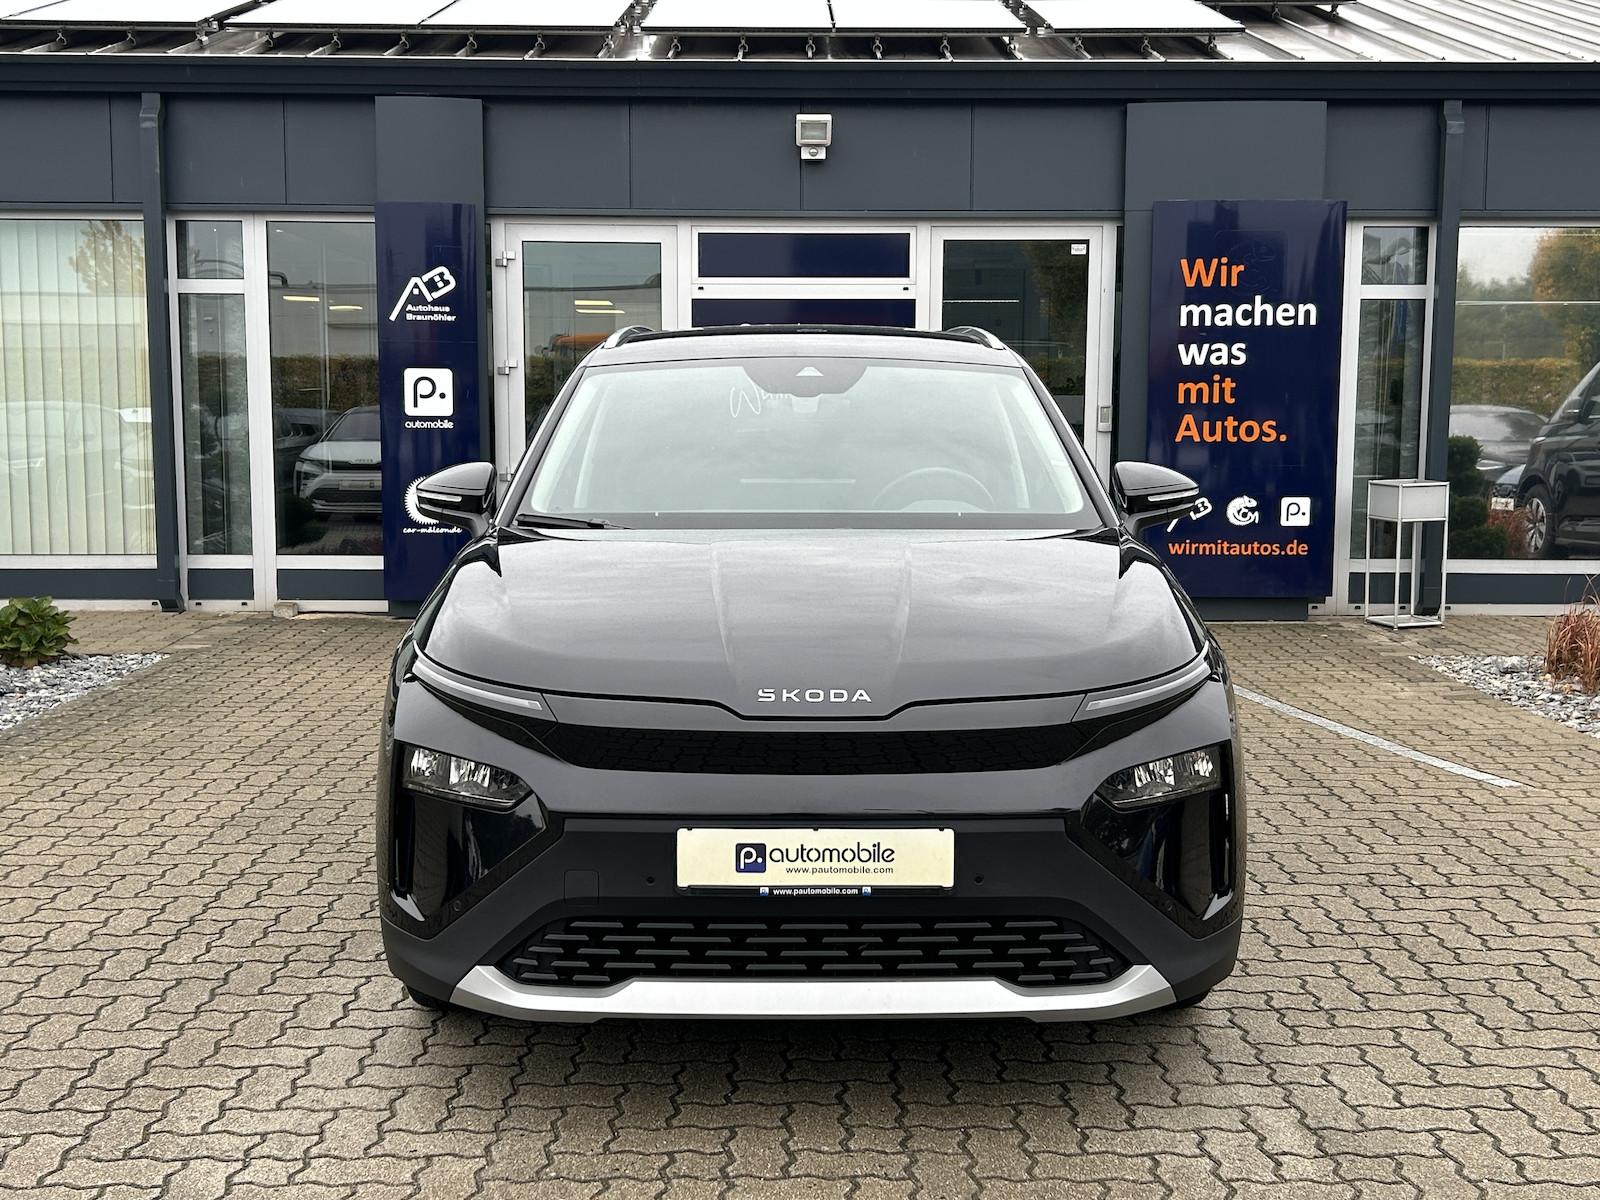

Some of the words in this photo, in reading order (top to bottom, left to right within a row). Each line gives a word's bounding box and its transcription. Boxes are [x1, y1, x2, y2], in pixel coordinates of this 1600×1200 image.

[1180, 256, 1245, 288] Wir
[405, 303, 451, 313] Autohaus
[1179, 294, 1318, 327] machen
[405, 313, 457, 322] Braunöhler
[1177, 342, 1247, 366] was
[1177, 374, 1237, 404] mit
[404, 419, 454, 429] automobile
[1174, 413, 1288, 443] Autos.
[1168, 539, 1309, 556] wirmitautos.de
[757, 688, 872, 703] SKODA
[769, 841, 895, 863] automobile
[785, 865, 894, 875] www.pautomobile.com
[772, 887, 859, 897] www.pautomobile.com
